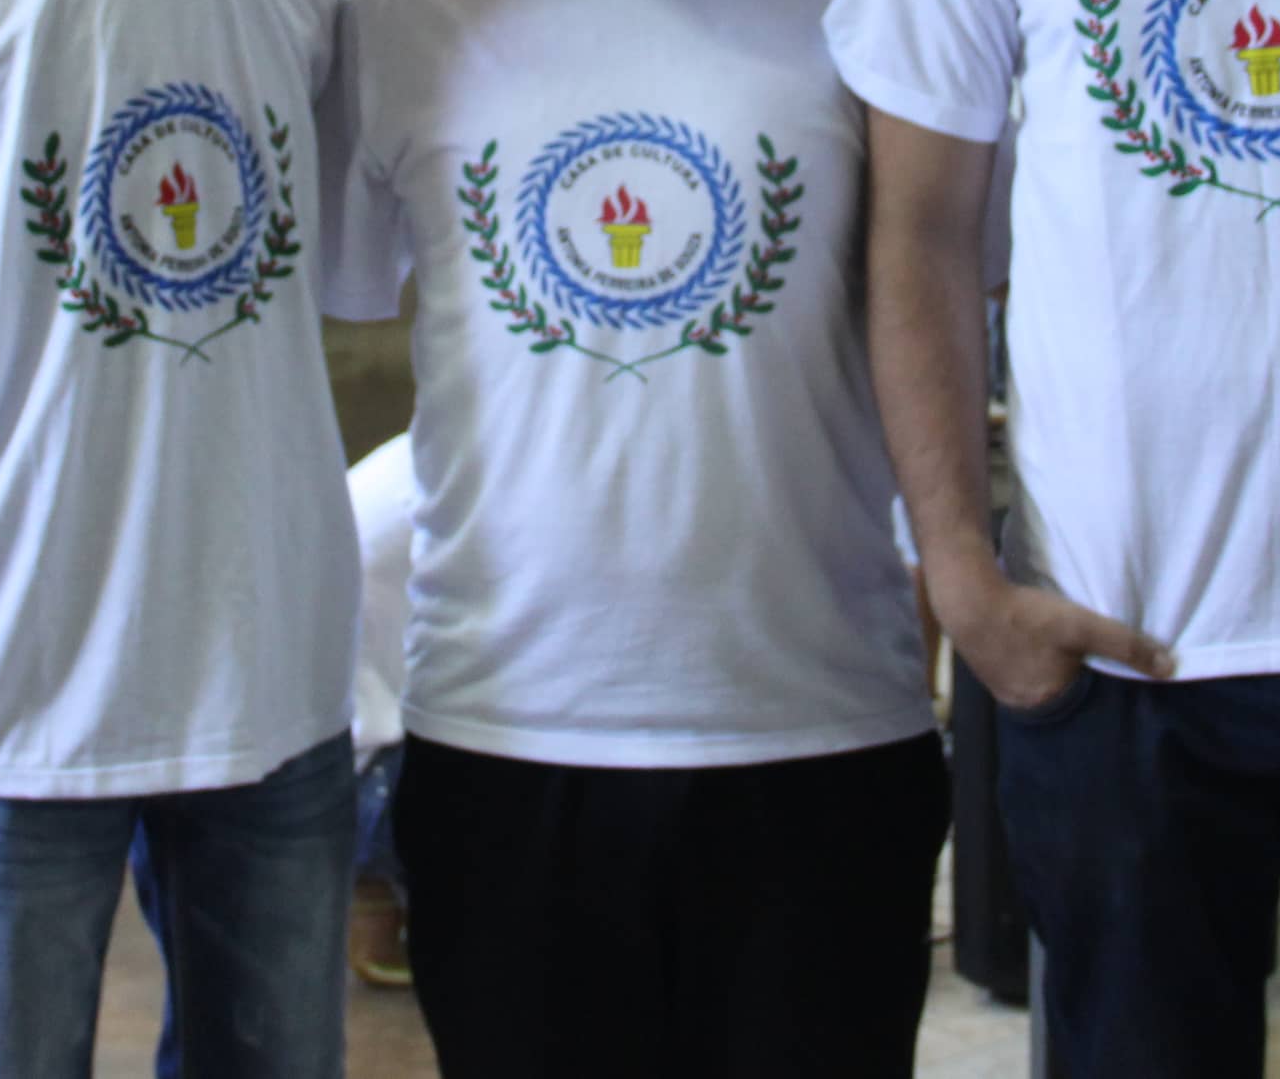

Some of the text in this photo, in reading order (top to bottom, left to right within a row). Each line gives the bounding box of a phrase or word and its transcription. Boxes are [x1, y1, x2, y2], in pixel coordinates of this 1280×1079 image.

[560, 143, 699, 190] CASA DE CULTURA
